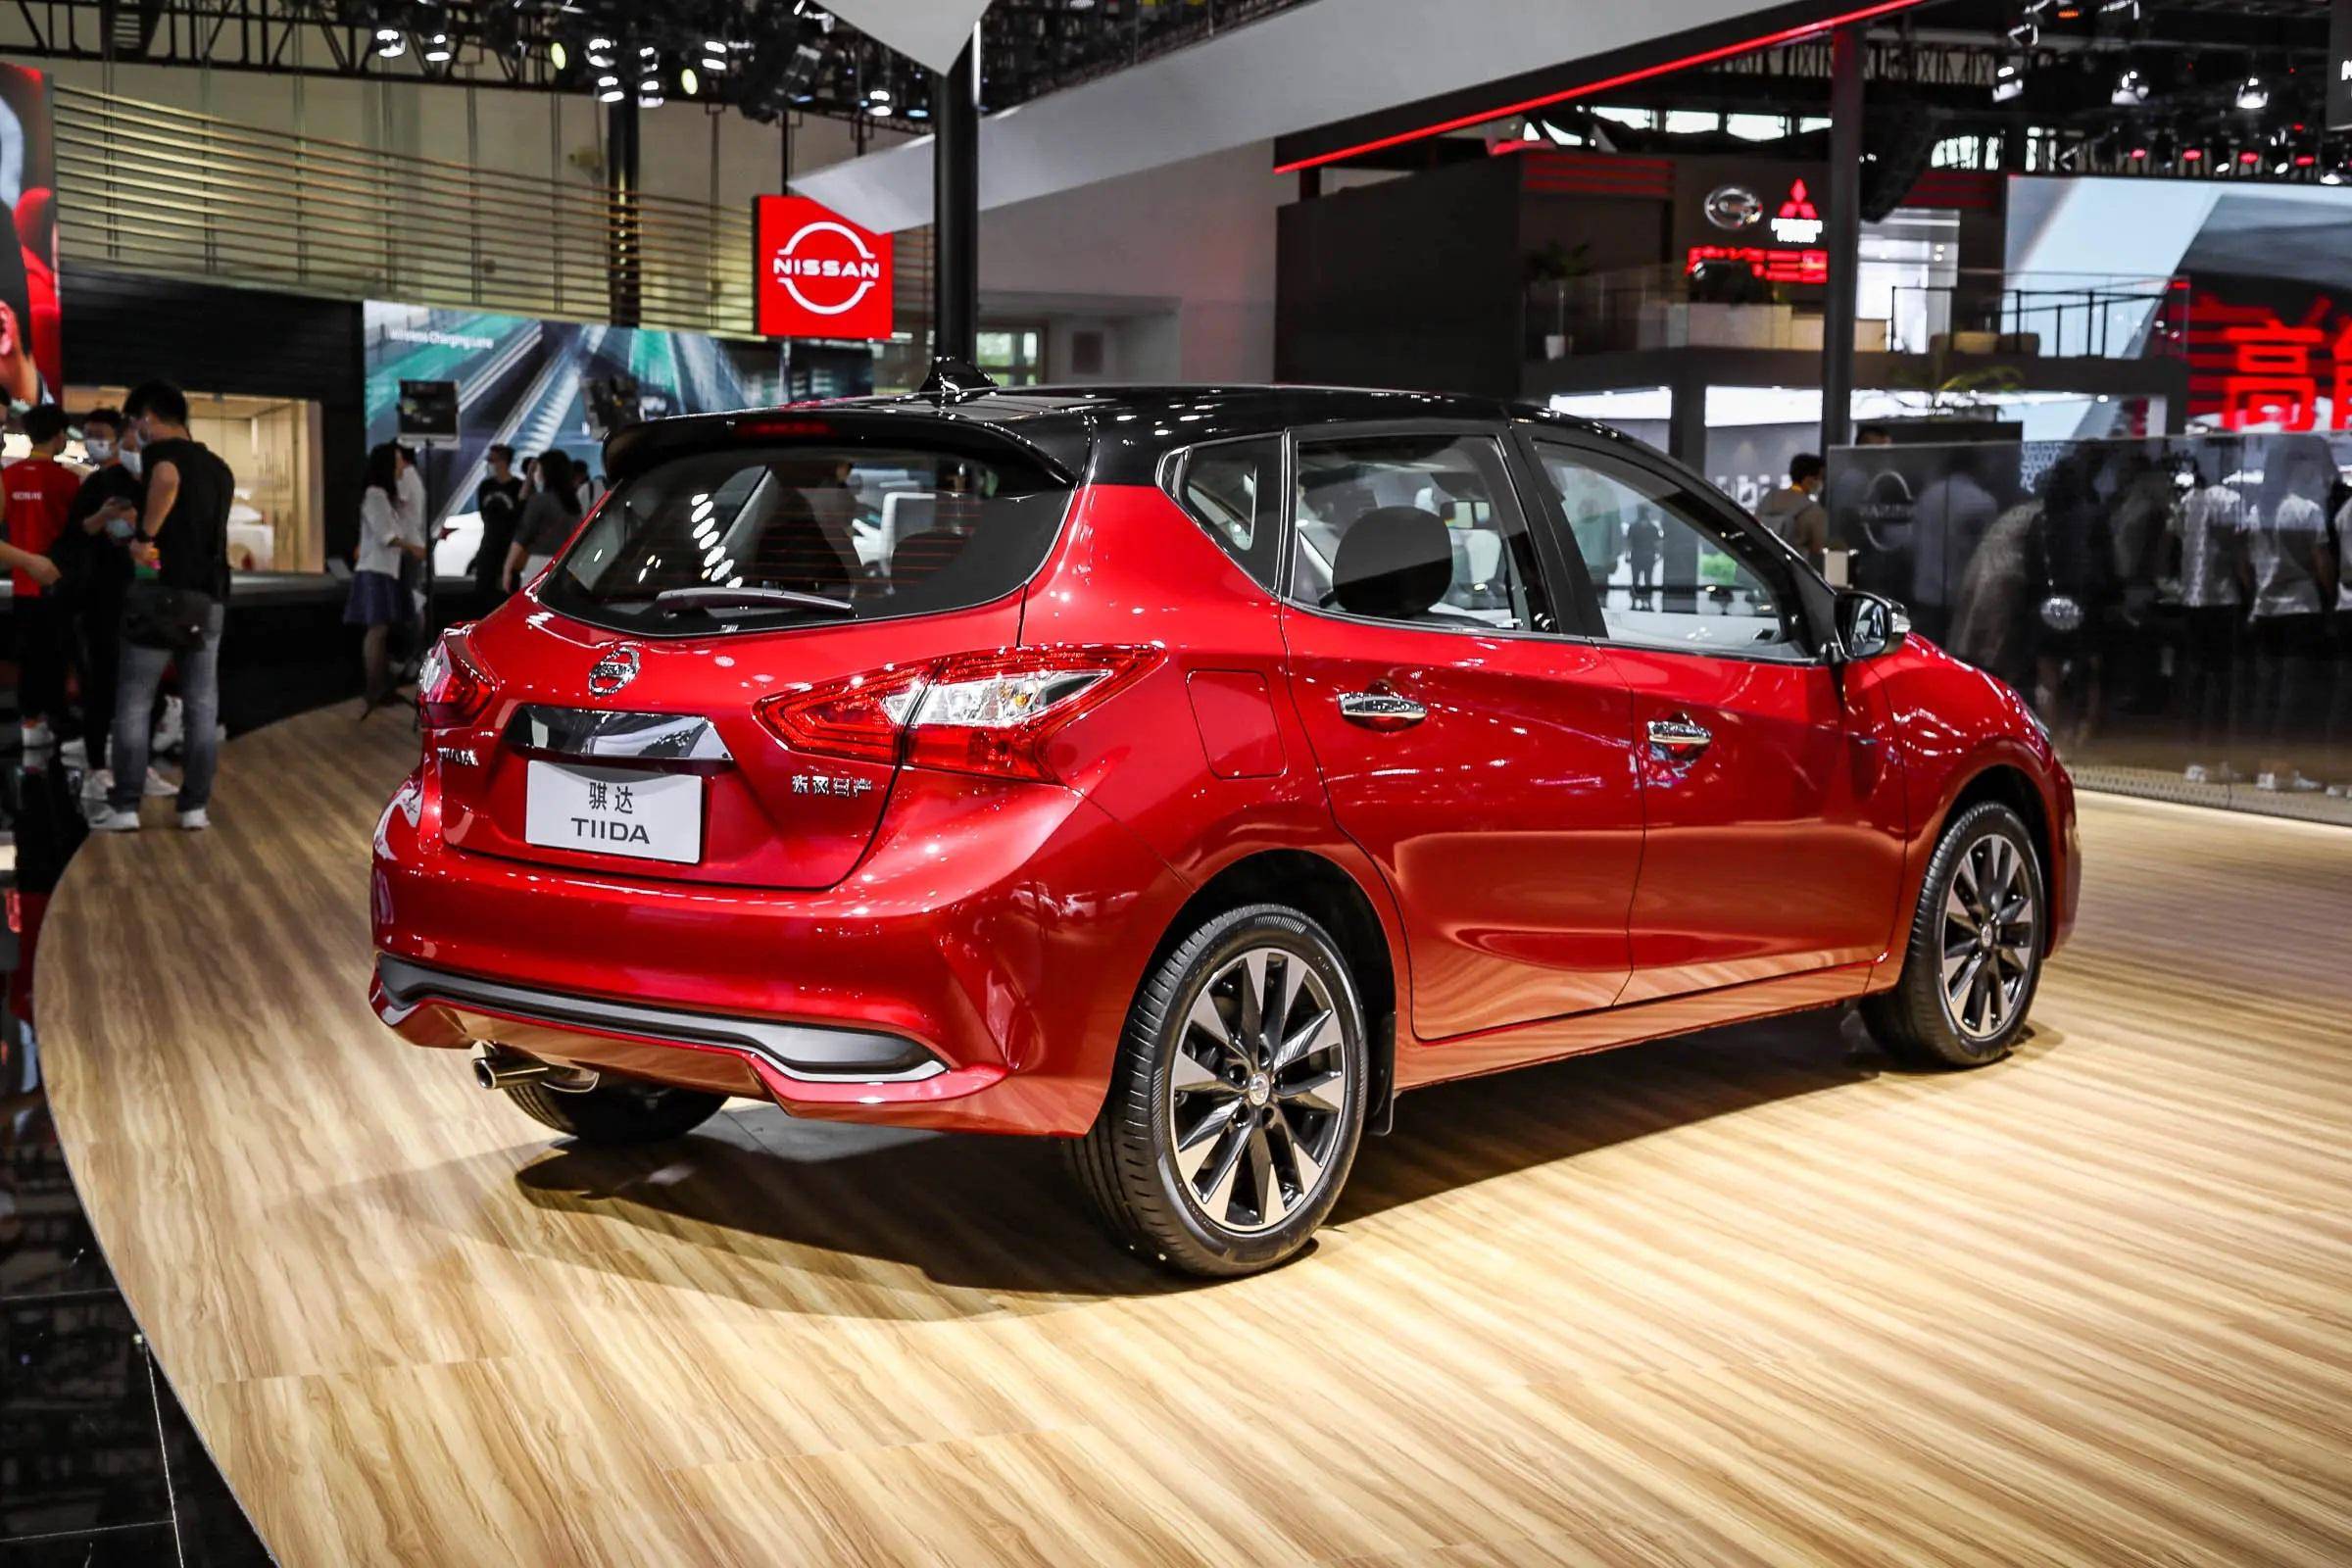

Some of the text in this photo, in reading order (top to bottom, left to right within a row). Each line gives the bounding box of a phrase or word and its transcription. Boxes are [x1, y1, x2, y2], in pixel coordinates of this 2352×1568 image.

[772, 257, 880, 278] NISSAN
[437, 747, 479, 766] TIIDA
[792, 774, 871, 797] 东风日产
[589, 781, 633, 814] 骐达
[570, 817, 650, 844] TIIDA
